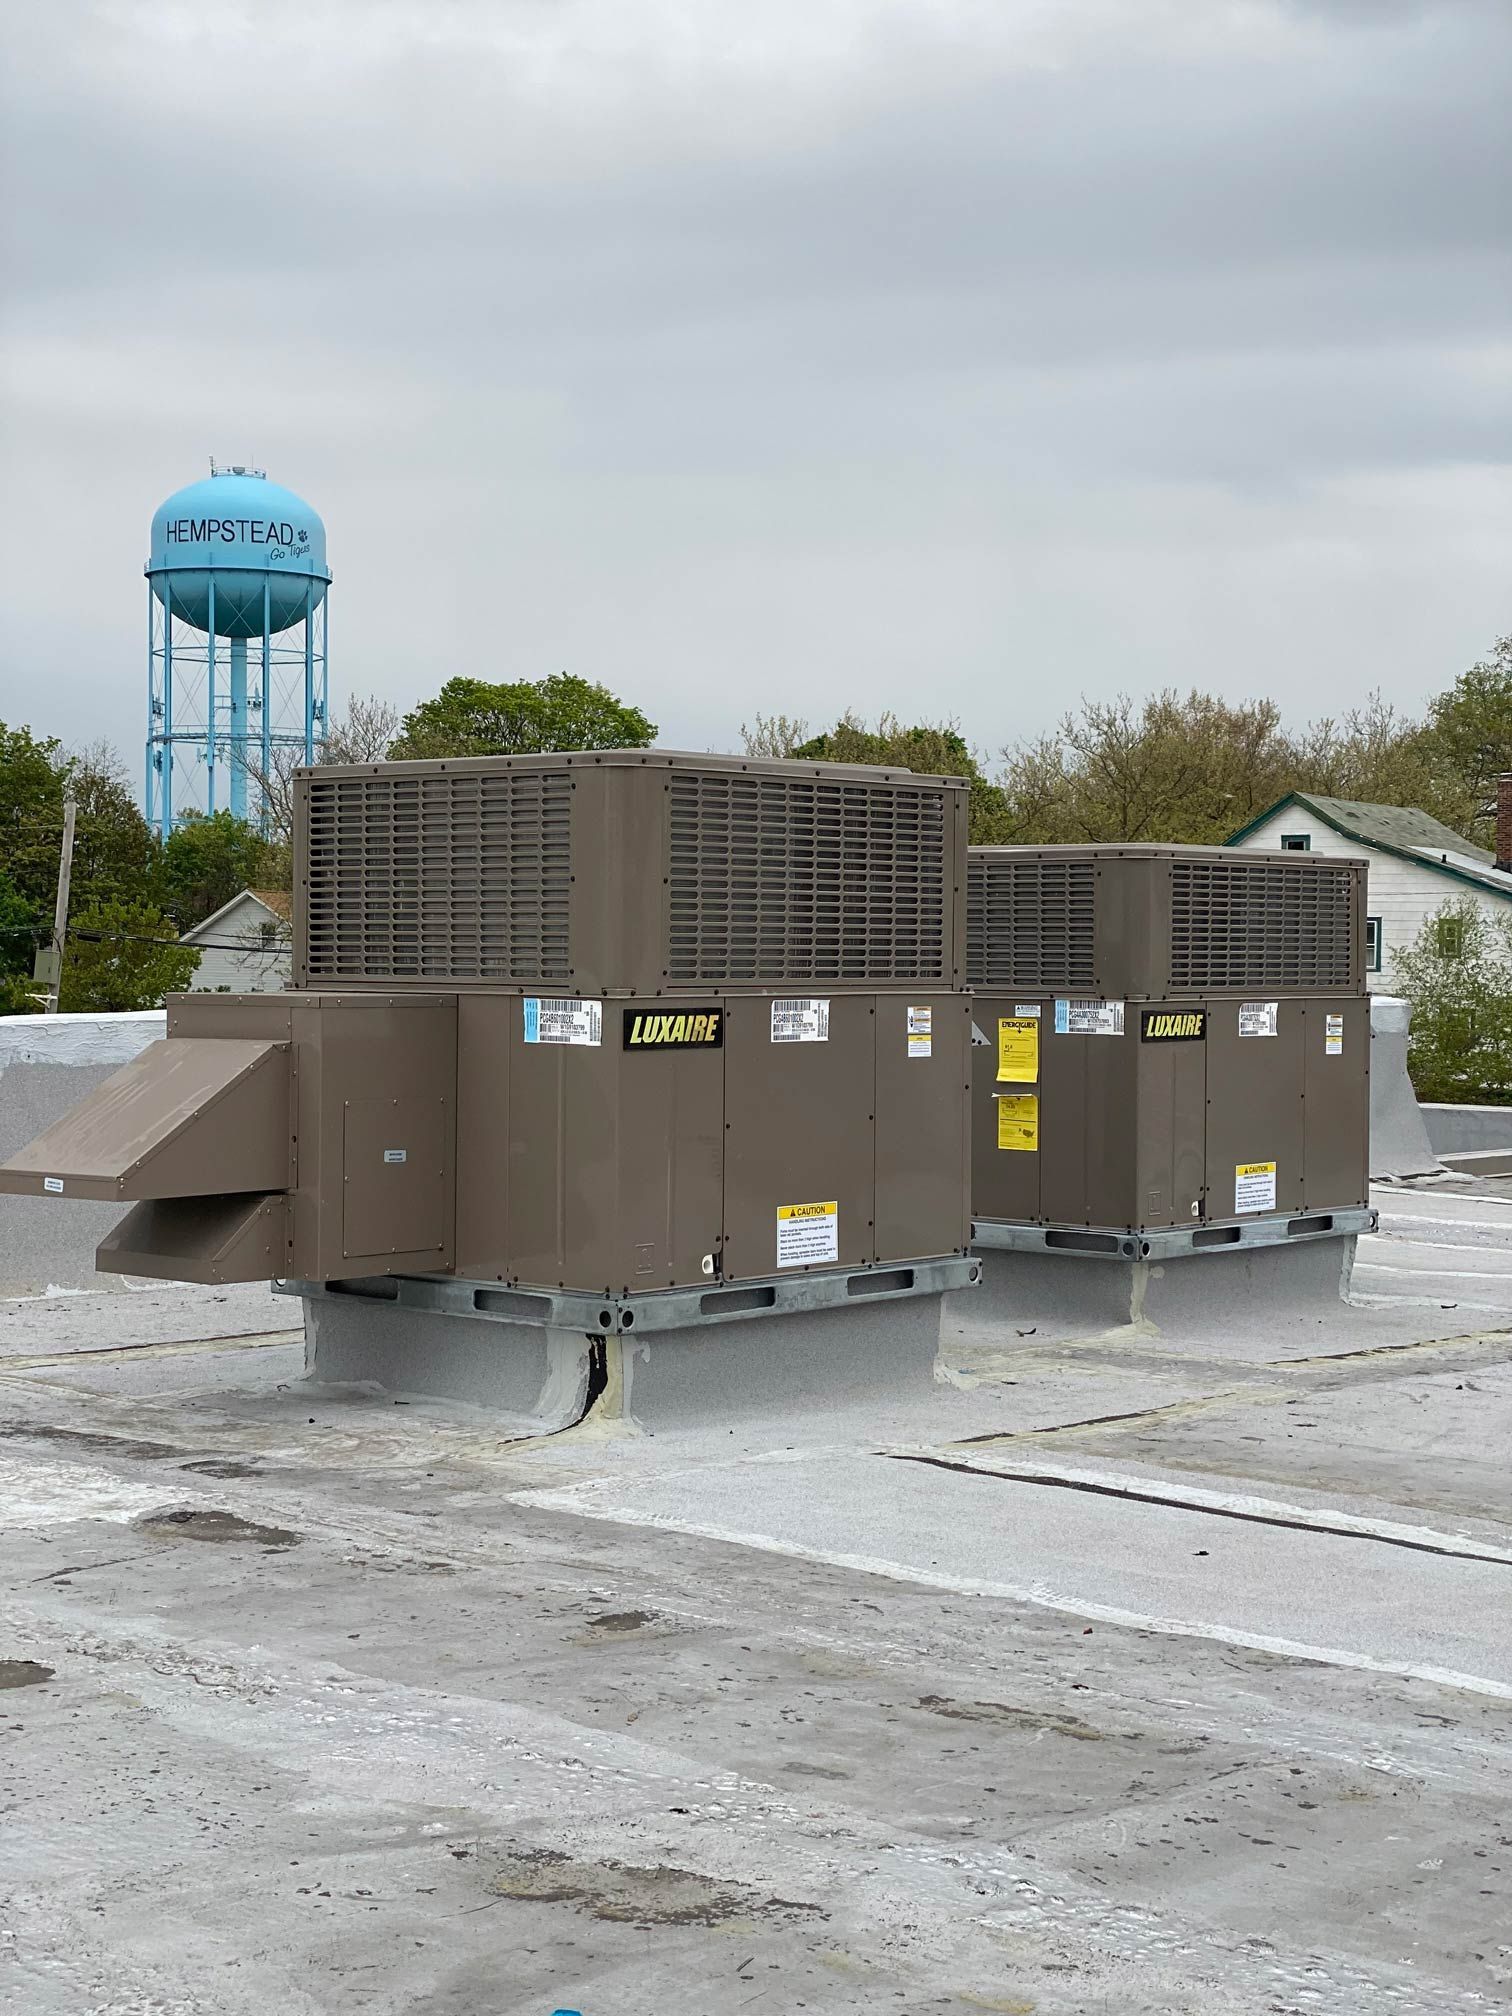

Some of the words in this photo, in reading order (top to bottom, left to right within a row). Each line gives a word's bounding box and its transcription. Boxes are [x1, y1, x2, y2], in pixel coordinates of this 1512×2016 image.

[166, 519, 294, 546] HEMPSTEAD
[270, 547, 285, 561] Go
[288, 543, 310, 559] Tigers
[630, 1015, 720, 1044] LUXAIRE
[1146, 1015, 1204, 1037] LUXAIRE
[1248, 1165, 1269, 1174] CAUTION
[797, 1206, 826, 1216] CAUTION
